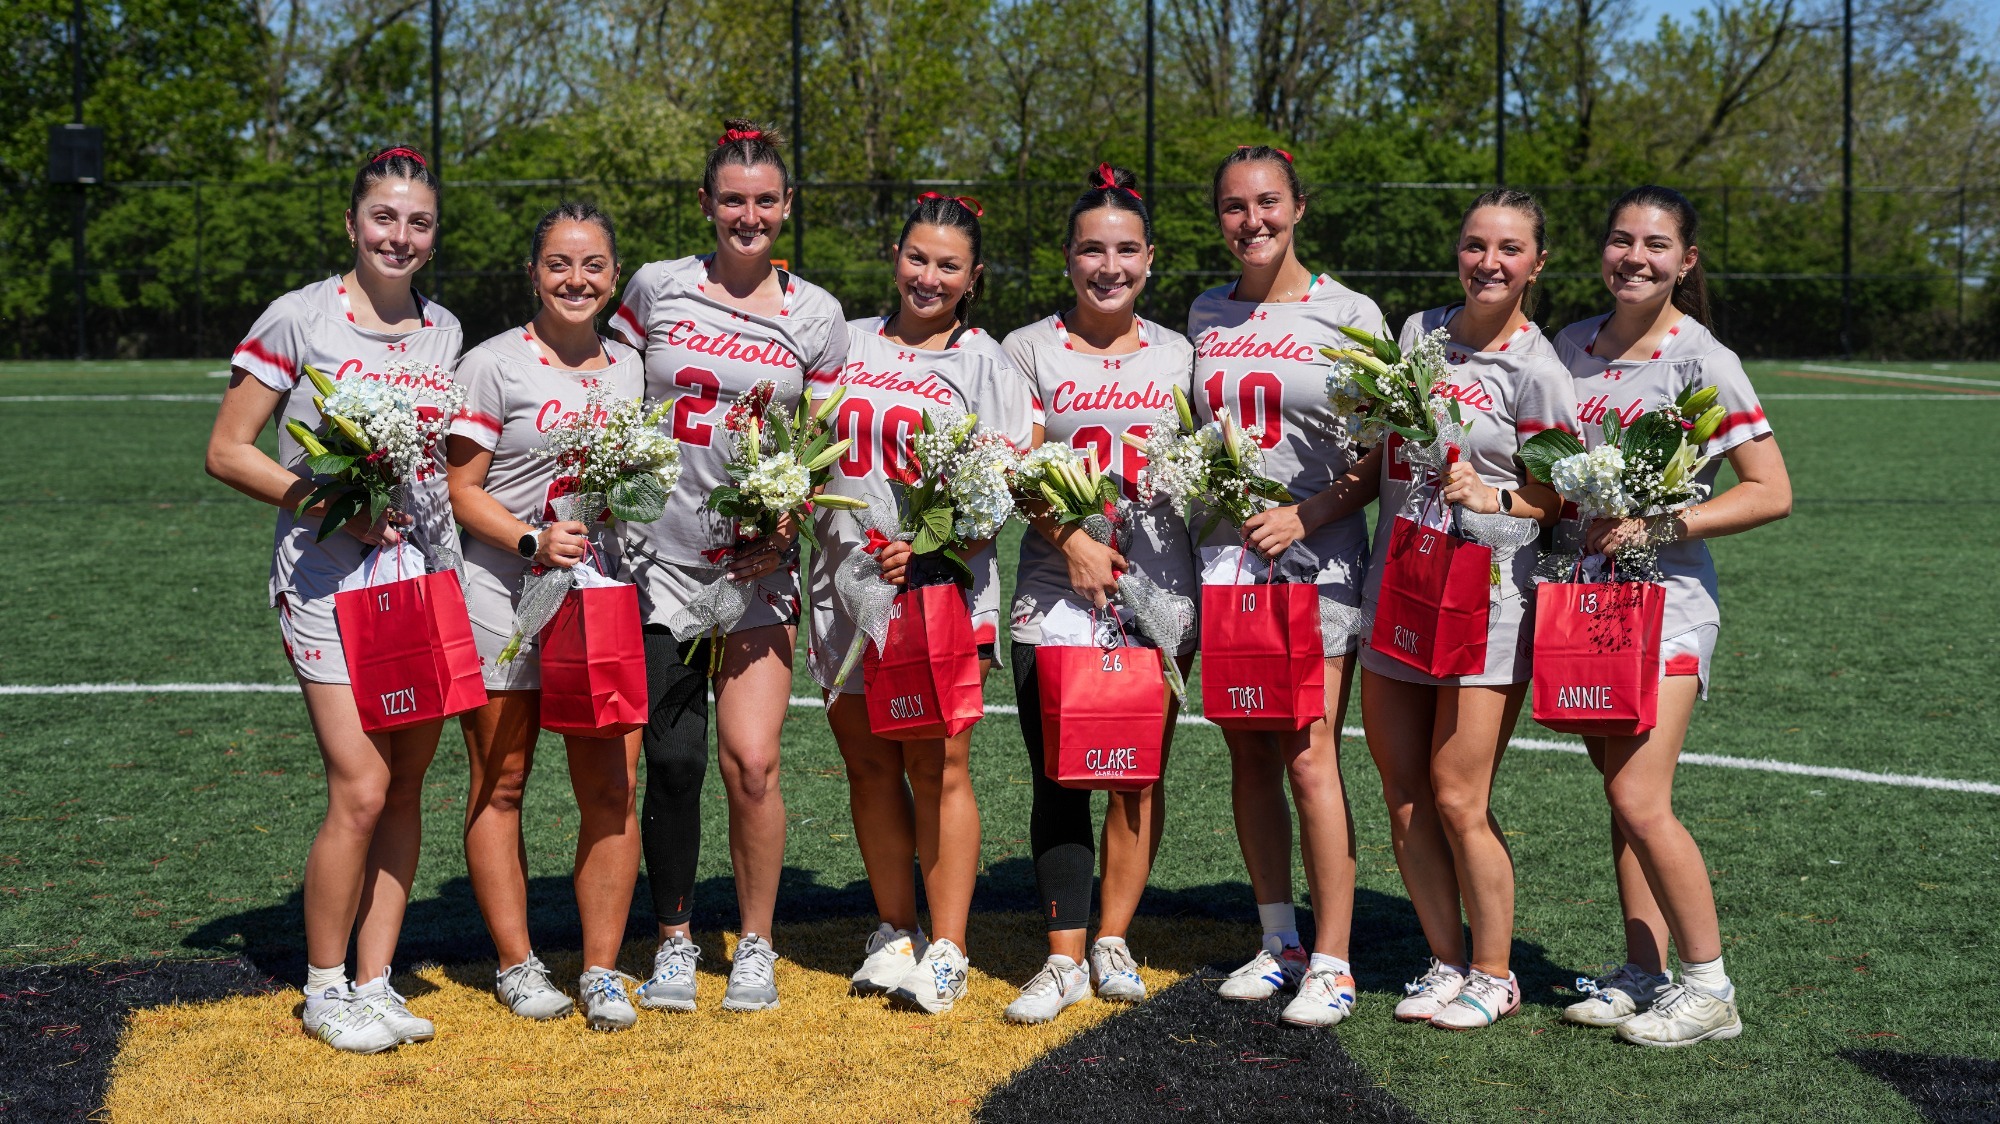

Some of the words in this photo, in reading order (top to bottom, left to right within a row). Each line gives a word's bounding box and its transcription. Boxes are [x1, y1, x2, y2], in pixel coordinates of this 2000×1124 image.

[668, 320, 798, 369] Catholic
[1197, 331, 1314, 363] Catholic
[839, 361, 953, 405] Catholic
[1052, 380, 1174, 414] Catholic
[1203, 369, 1284, 451] 10
[535, 399, 609, 434] Cath
[836, 396, 925, 489] 00
[1418, 533, 1436, 555] 27
[377, 592, 390, 612] 17
[1241, 592, 1256, 612] 10
[1579, 593, 1598, 614] 13
[1101, 654, 1123, 672] 26
[380, 686, 417, 716] IZZY
[890, 693, 924, 719] SULLY
[1227, 686, 1265, 710] TORI
[1557, 685, 1613, 709] ANNIE
[1085, 747, 1138, 770] CLARE
